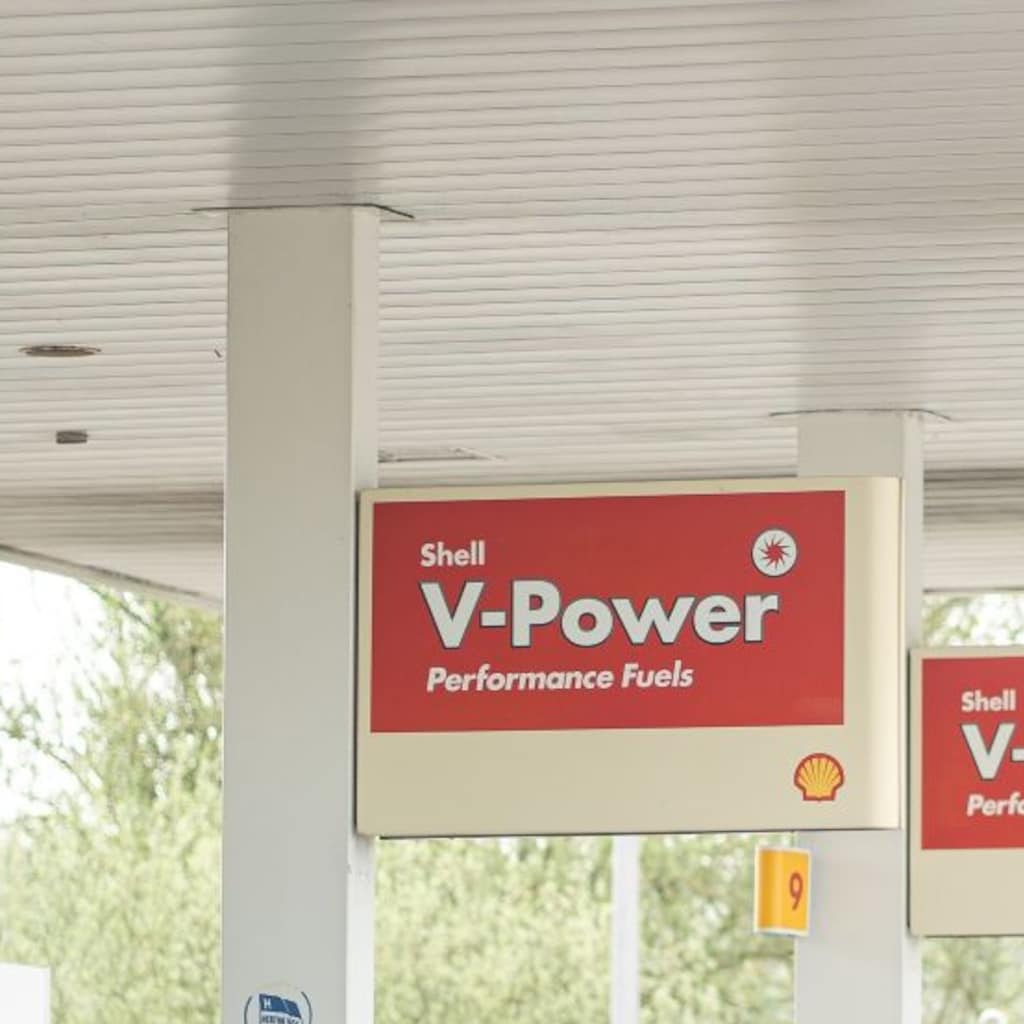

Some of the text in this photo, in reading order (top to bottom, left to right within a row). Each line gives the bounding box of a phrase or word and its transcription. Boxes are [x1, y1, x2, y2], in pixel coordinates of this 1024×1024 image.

[420, 541, 485, 568] Shell
[419, 579, 780, 650] V-Power
[427, 660, 694, 692] Performance Fuels
[961, 689, 1016, 712] Shell
[788, 871, 804, 911] 9
